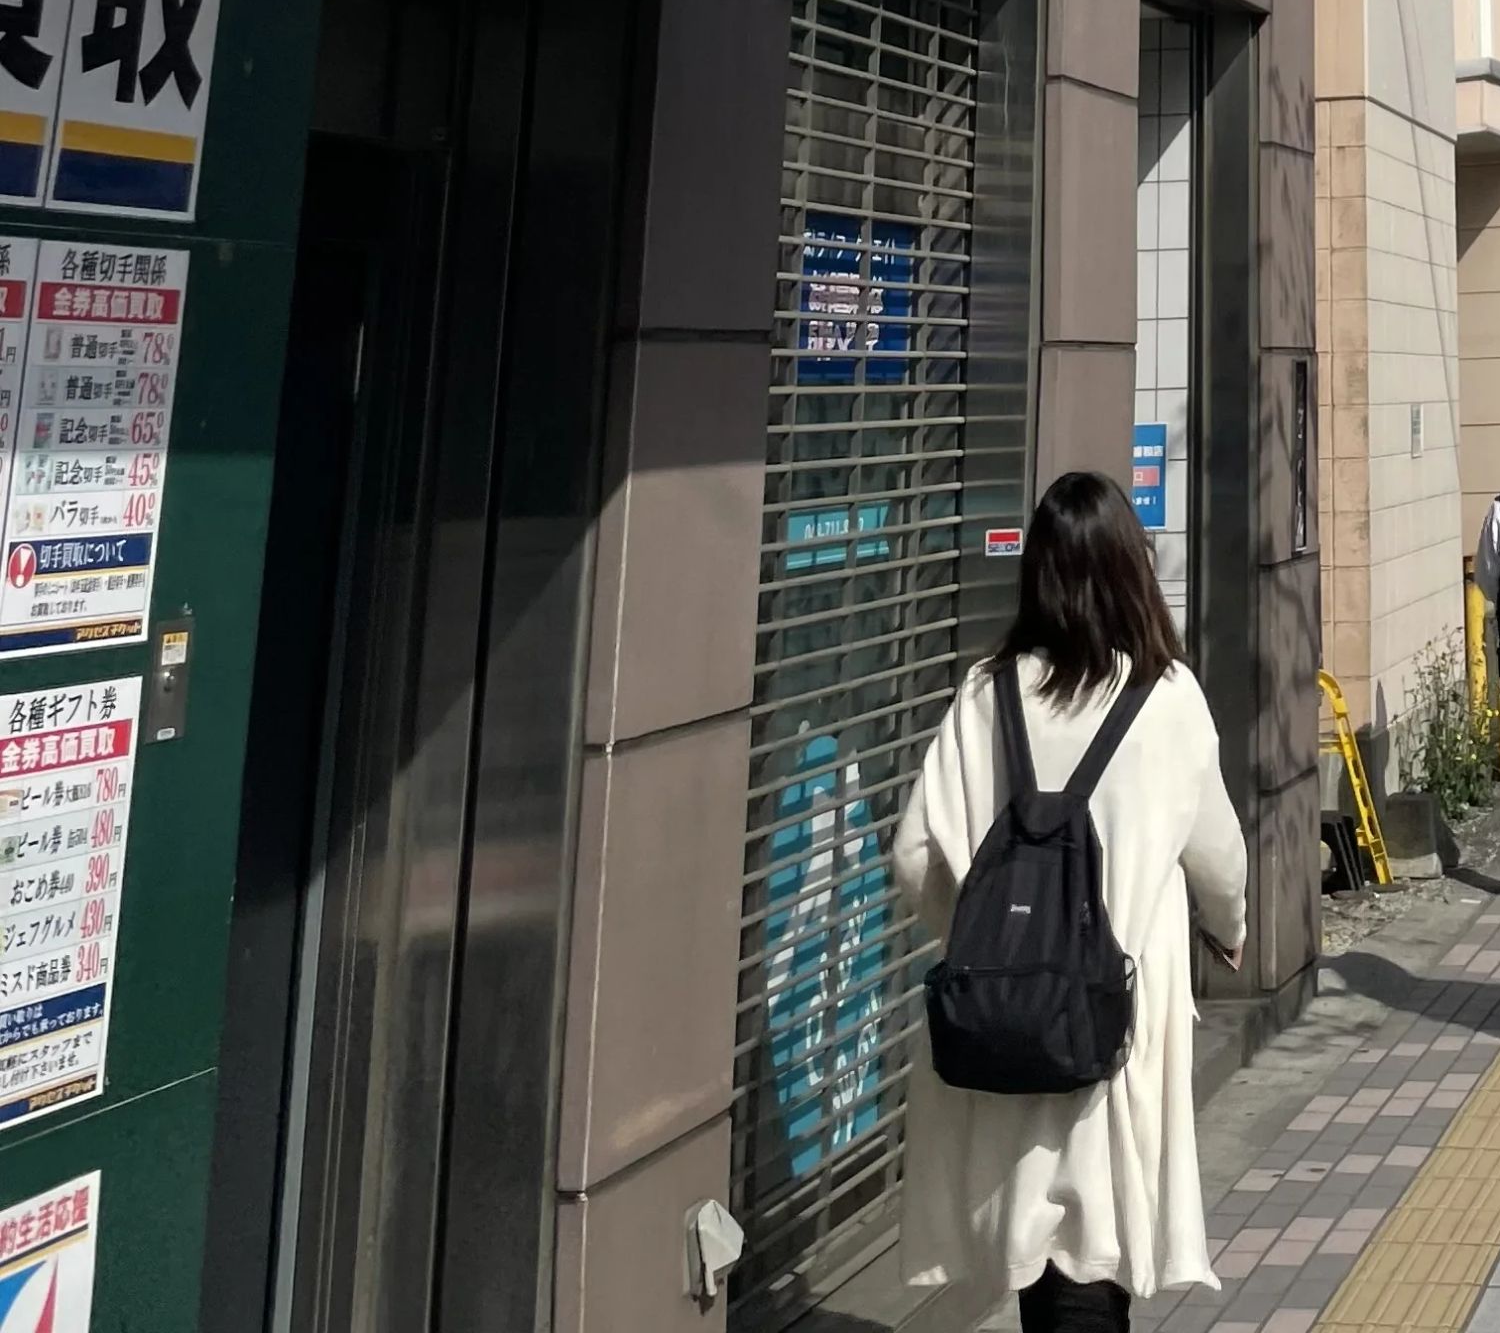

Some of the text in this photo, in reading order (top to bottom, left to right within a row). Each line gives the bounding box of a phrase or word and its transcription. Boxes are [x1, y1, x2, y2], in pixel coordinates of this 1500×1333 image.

[52, 286, 165, 320] 金券高価買取
[39, 539, 127, 569] 切手買取について
[8, 685, 118, 735] 各種ギフト券
[1, 727, 116, 774] 金券高価買取
